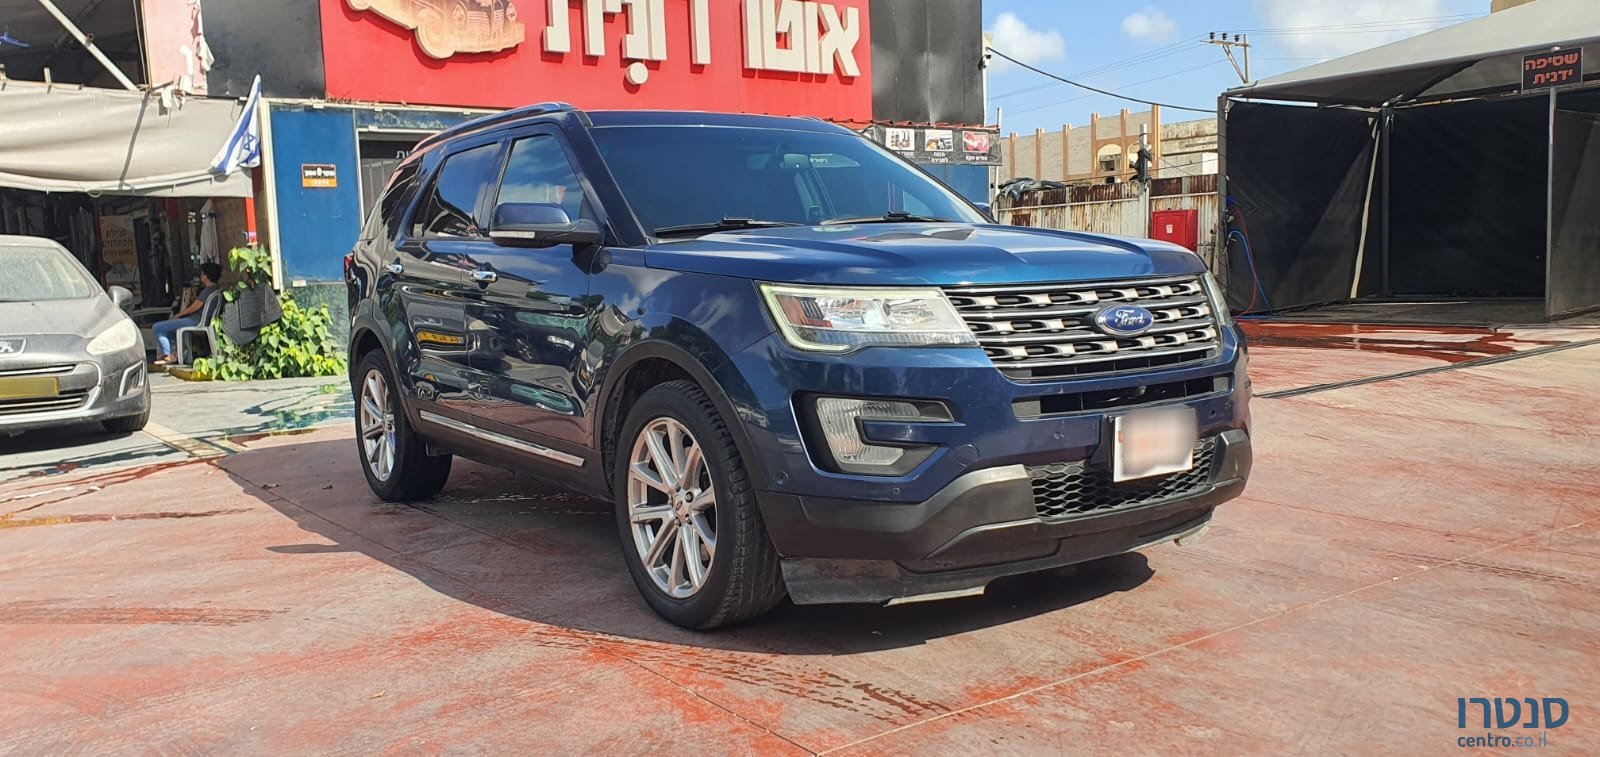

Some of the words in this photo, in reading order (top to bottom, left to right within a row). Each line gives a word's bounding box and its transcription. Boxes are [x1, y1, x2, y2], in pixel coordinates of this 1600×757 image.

[742, 0, 861, 77] אוטו
[1532, 69, 1574, 85] ידנית
[1114, 309, 1145, 326] Ford
